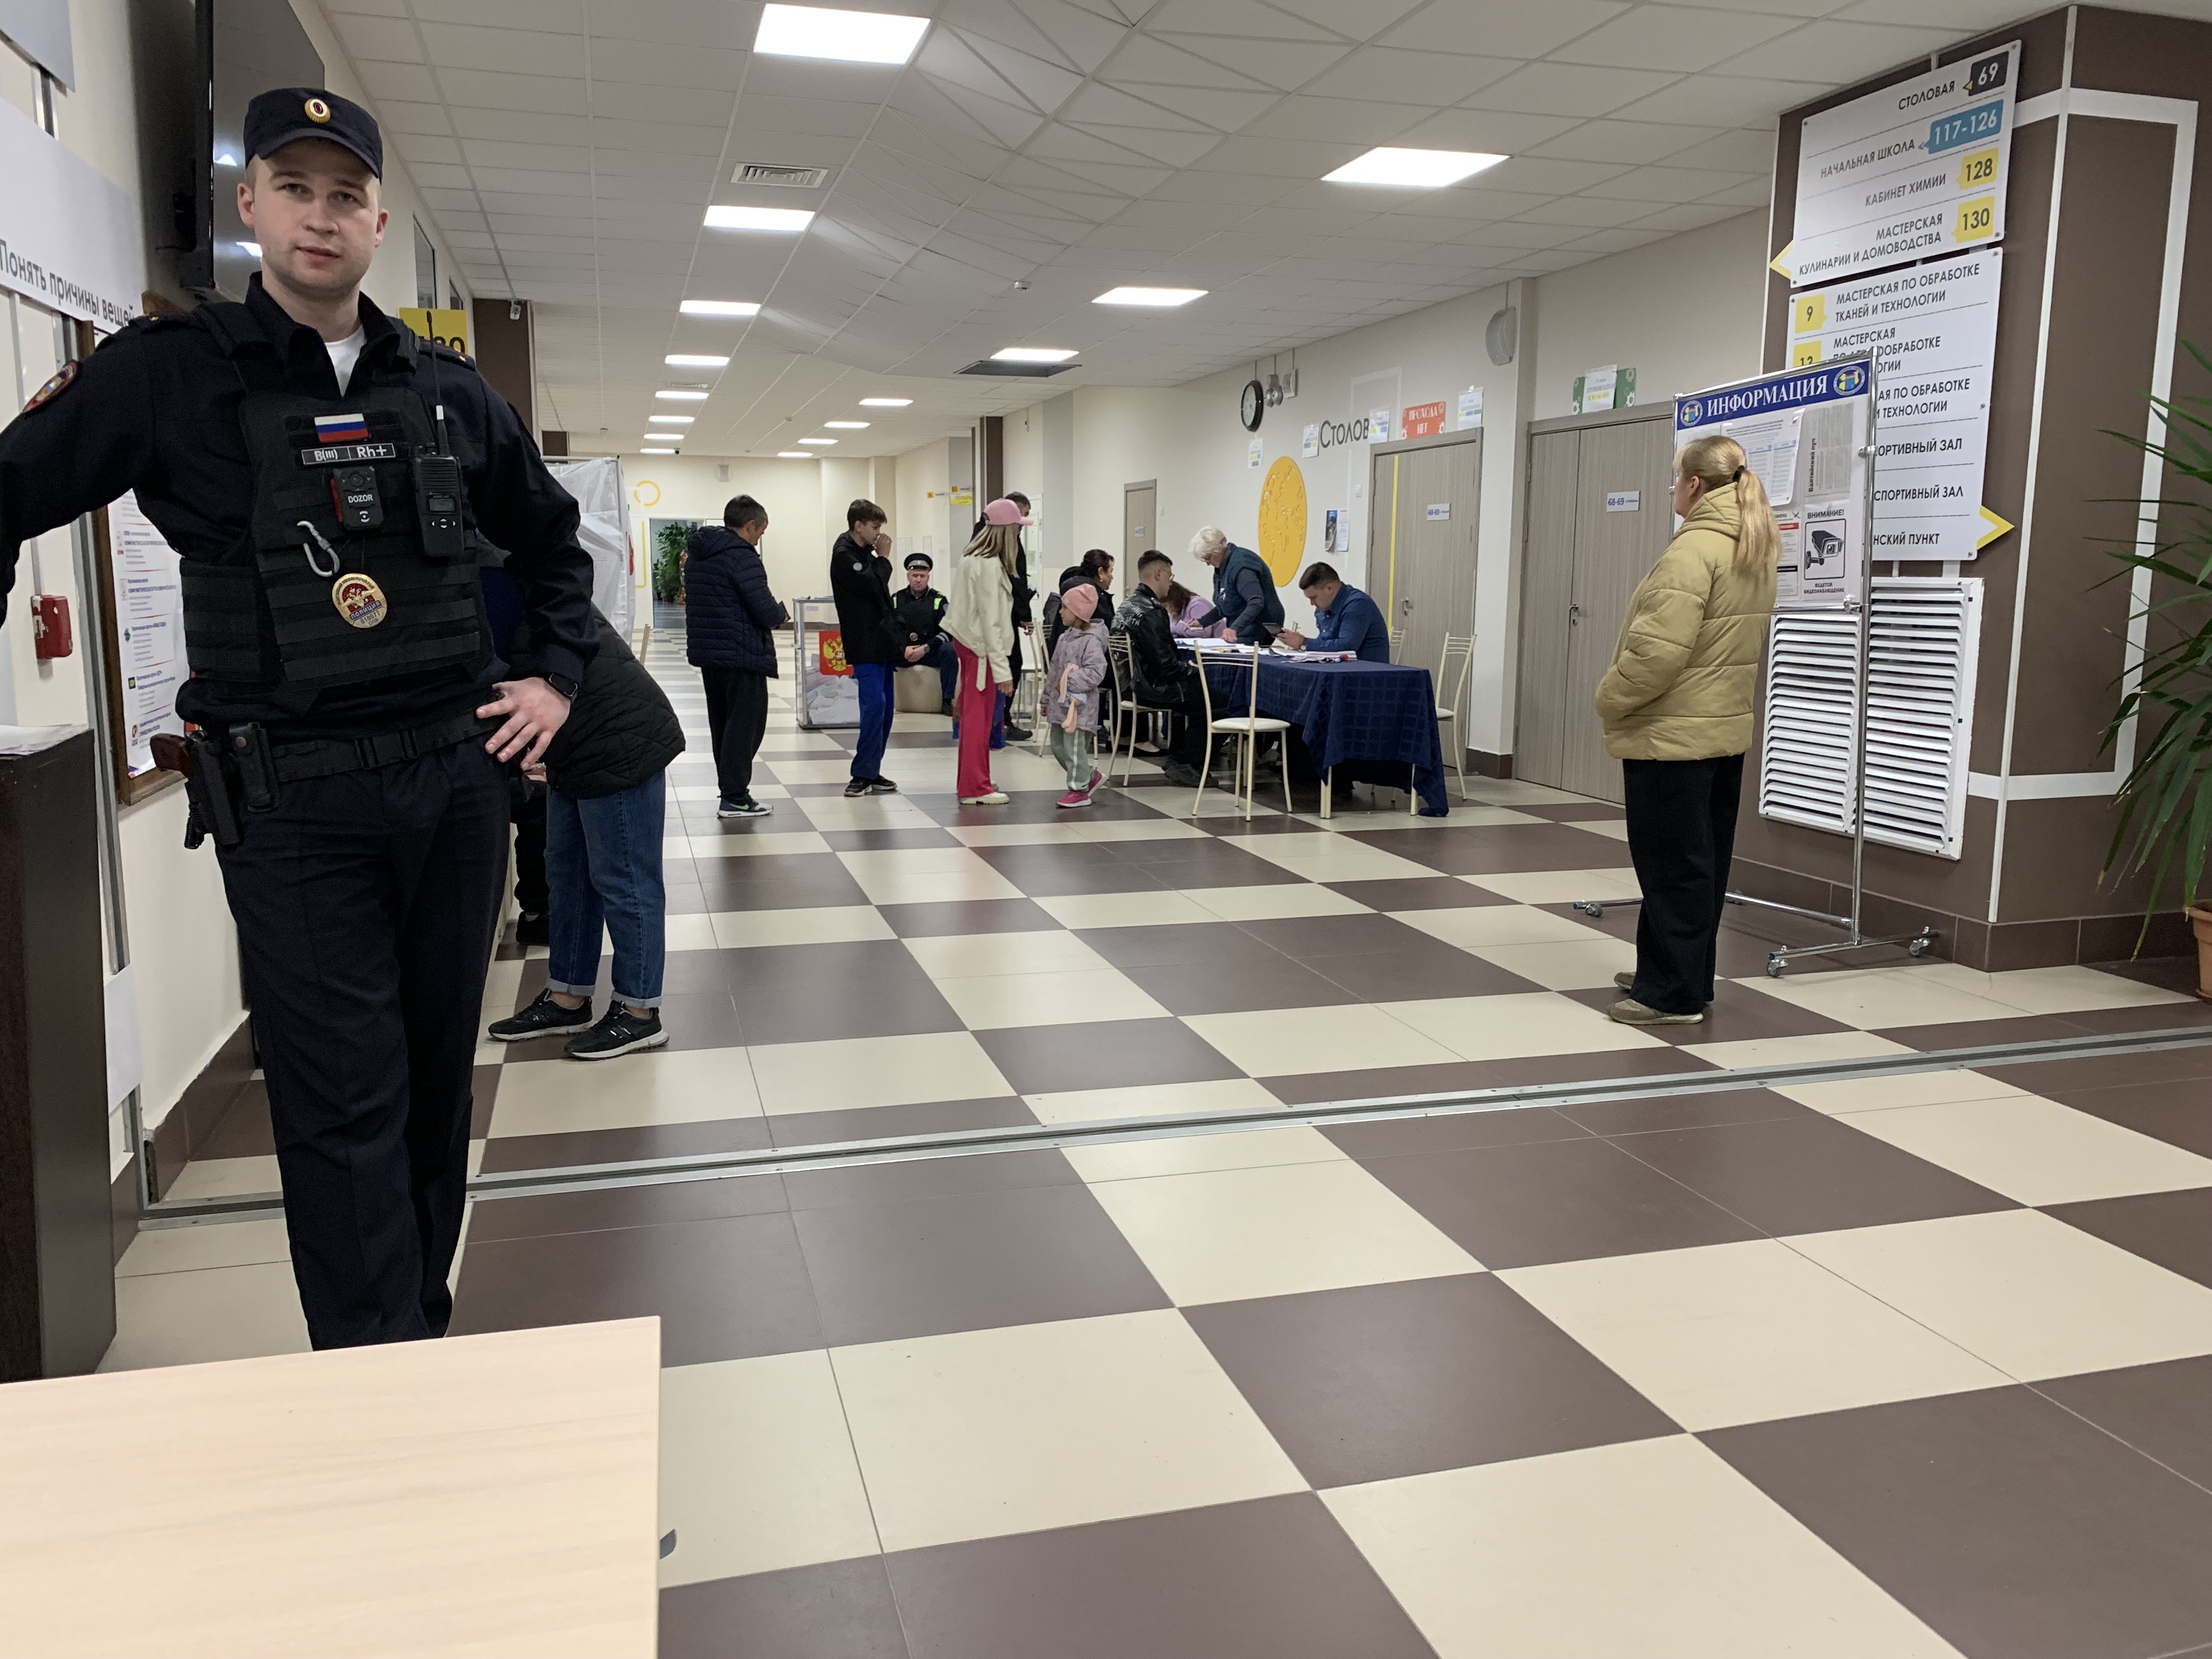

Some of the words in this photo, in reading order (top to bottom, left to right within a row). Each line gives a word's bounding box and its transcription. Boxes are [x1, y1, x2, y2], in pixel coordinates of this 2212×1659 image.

[1898, 81, 1955, 110] СТОЛОВАЯ
[1978, 63, 1999, 85] 69
[1821, 151, 1875, 179] НАЧАЛЬНАЯ
[1877, 139, 1915, 160] ШКОЛА
[1935, 109, 1997, 144] 117-126
[1865, 185, 1906, 206] КАБИНЕТ
[1909, 173, 1946, 195] ХИМИИ
[1965, 158, 1993, 182] 128
[1876, 213, 1943, 240] МАСТЕРСКАЯ
[1962, 208, 1990, 231] 130
[1799, 253, 1850, 275] КУЛИНАРИИ
[1853, 251, 1859, 263] И
[1861, 232, 1941, 262] ДОМОВОДСТВА
[0, 238, 46, 291] Понять
[49, 272, 99, 317] причины
[1836, 281, 1899, 304] МАСТЕРСКАЯ
[1901, 278, 1916, 291] ПО
[1920, 263, 1980, 287] ОБРАБОТКЕ
[1807, 306, 1813, 321] 9
[1836, 304, 1869, 323] ТКАНЕЙ
[1872, 304, 1878, 315] И
[1881, 290, 1946, 313] ТЕХНОЛОГИИ
[1833, 328, 1895, 349] МАСТЕРСКАЯ
[1707, 375, 1828, 417] ИНФОРМАЦИЯ
[1893, 387, 1908, 399] ПО
[1911, 378, 1970, 397] ОБРАБОТКЕ
[1883, 400, 1948, 419] ТЕХНОЛОГИИ
[357, 445, 387, 458] Rh+
[1875, 437, 1937, 457] ОРТИВНЫЙ
[1940, 438, 1962, 451] ЗАЛ
[348, 494, 373, 503] DOZOR
[1874, 484, 1940, 501] СПОРТИВНЫЙ
[1942, 486, 1963, 498] ЗАЛ
[1808, 509, 1844, 519] ВНИМАНИЕ!
[1909, 533, 1940, 545] ПУНКТ
[351, 601, 381, 619] ПОЛИЦИЯ
